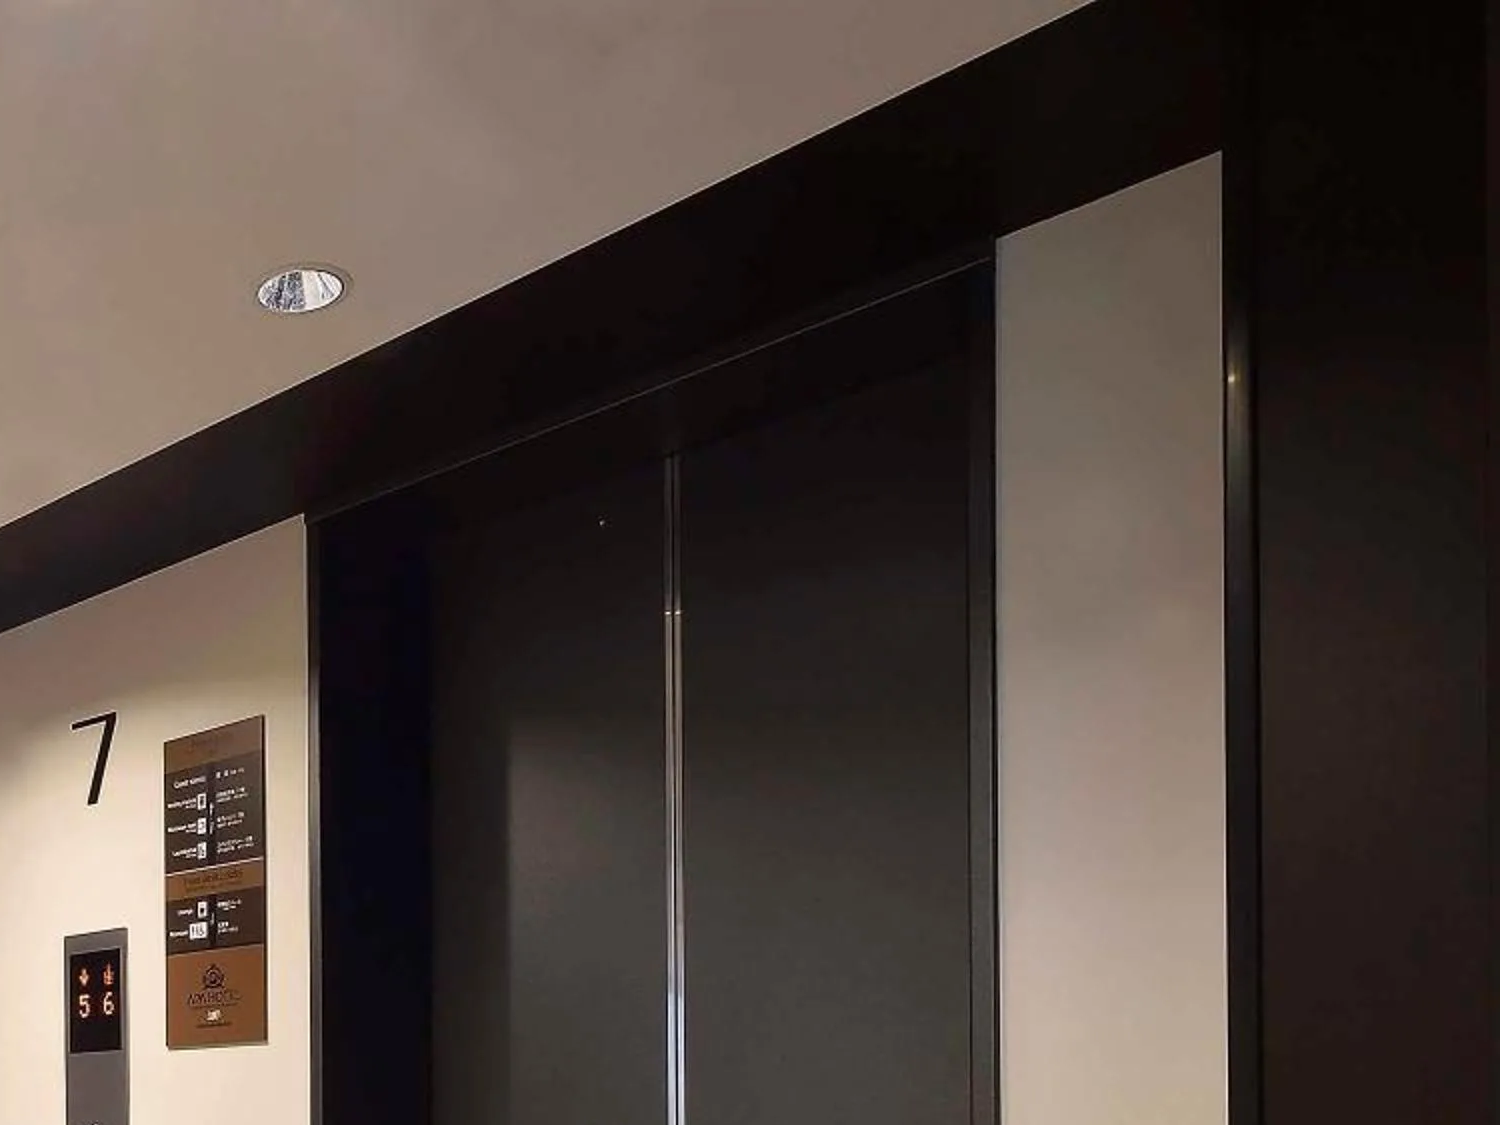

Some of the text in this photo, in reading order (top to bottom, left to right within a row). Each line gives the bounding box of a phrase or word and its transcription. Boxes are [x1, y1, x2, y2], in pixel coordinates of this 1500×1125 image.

[72, 712, 117, 806] 7
[79, 991, 115, 1018] 5 6
